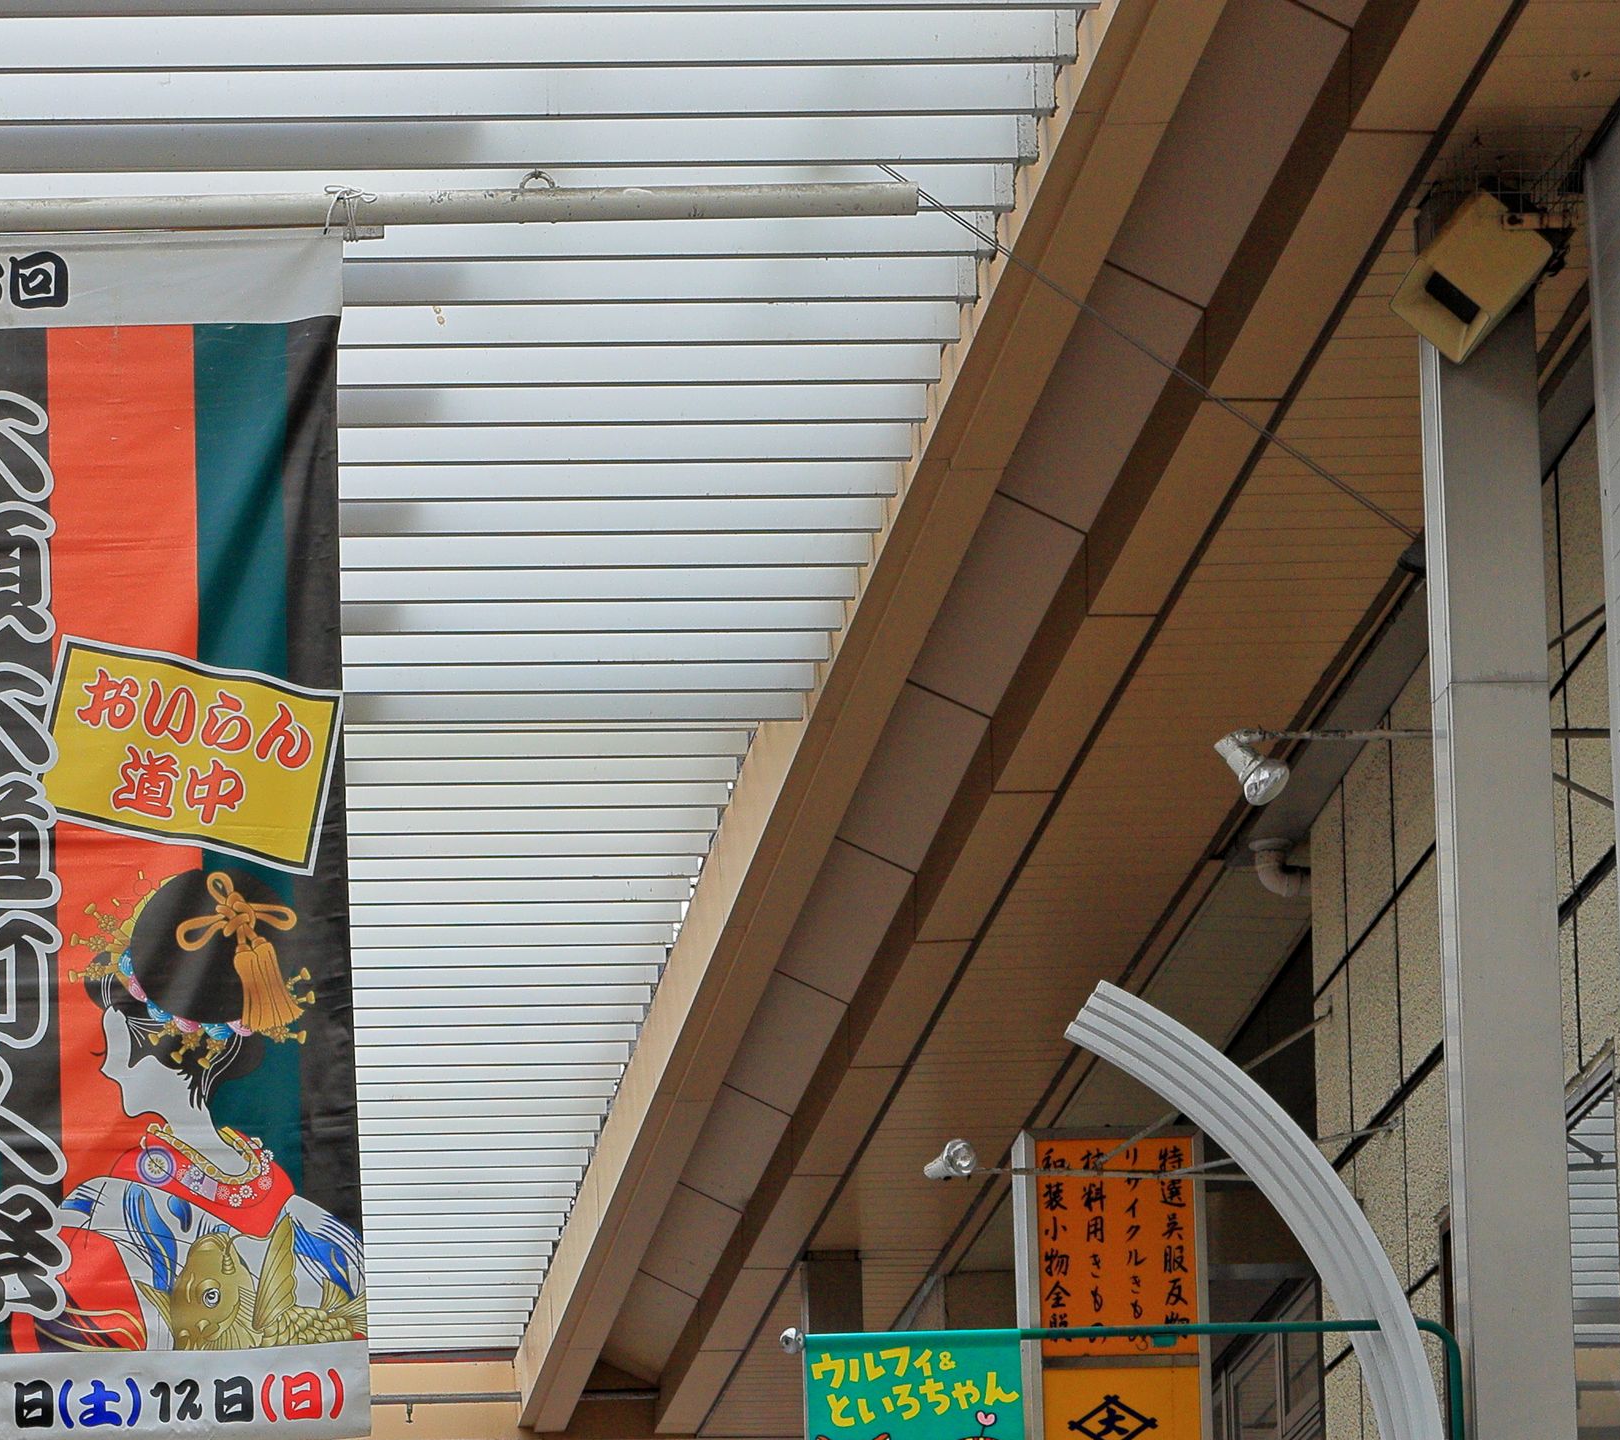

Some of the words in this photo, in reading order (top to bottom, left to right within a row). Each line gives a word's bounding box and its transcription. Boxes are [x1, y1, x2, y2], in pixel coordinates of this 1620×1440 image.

[76, 668, 315, 773] おいらん
[110, 747, 249, 826] 道中
[825, 1371, 1020, 1429] といろちゃん
